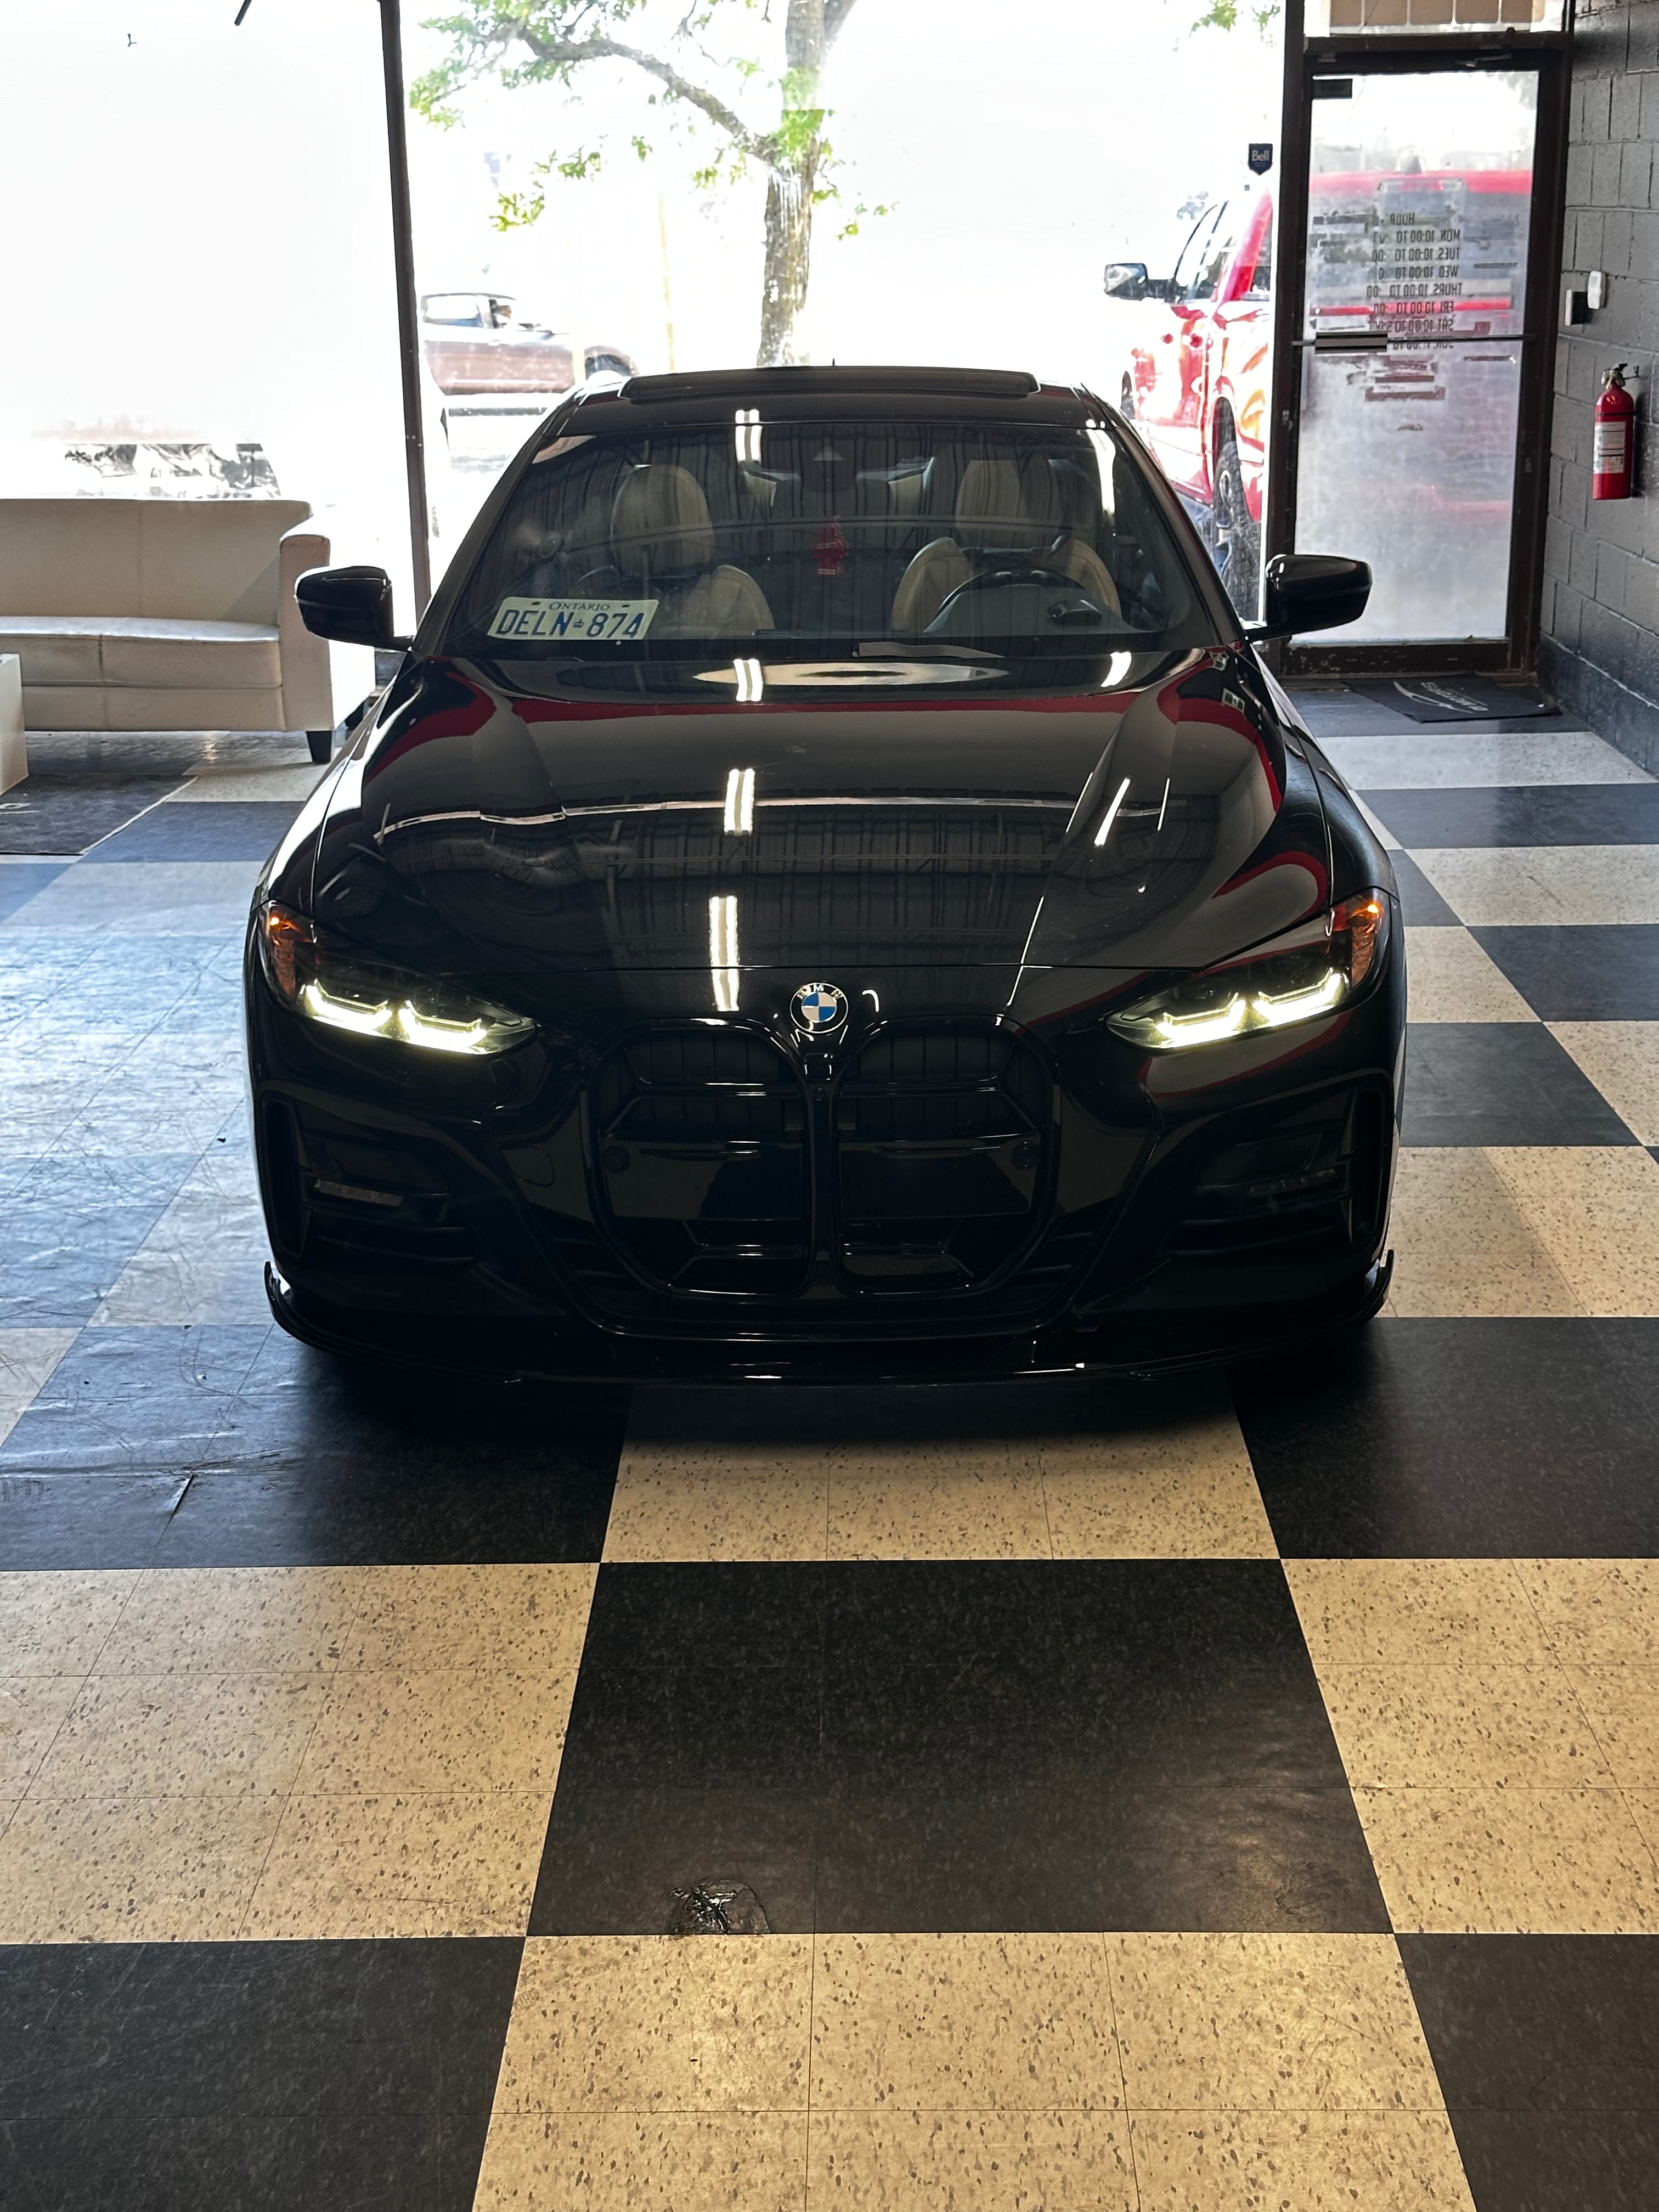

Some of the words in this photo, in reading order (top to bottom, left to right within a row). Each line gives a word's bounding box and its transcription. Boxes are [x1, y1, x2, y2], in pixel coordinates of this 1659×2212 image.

[1252, 150, 1269, 161] Bell
[549, 601, 610, 611] ONTARIO
[496, 610, 574, 636] DELN
[585, 612, 645, 639] 874
[797, 984, 844, 1000] BMW
